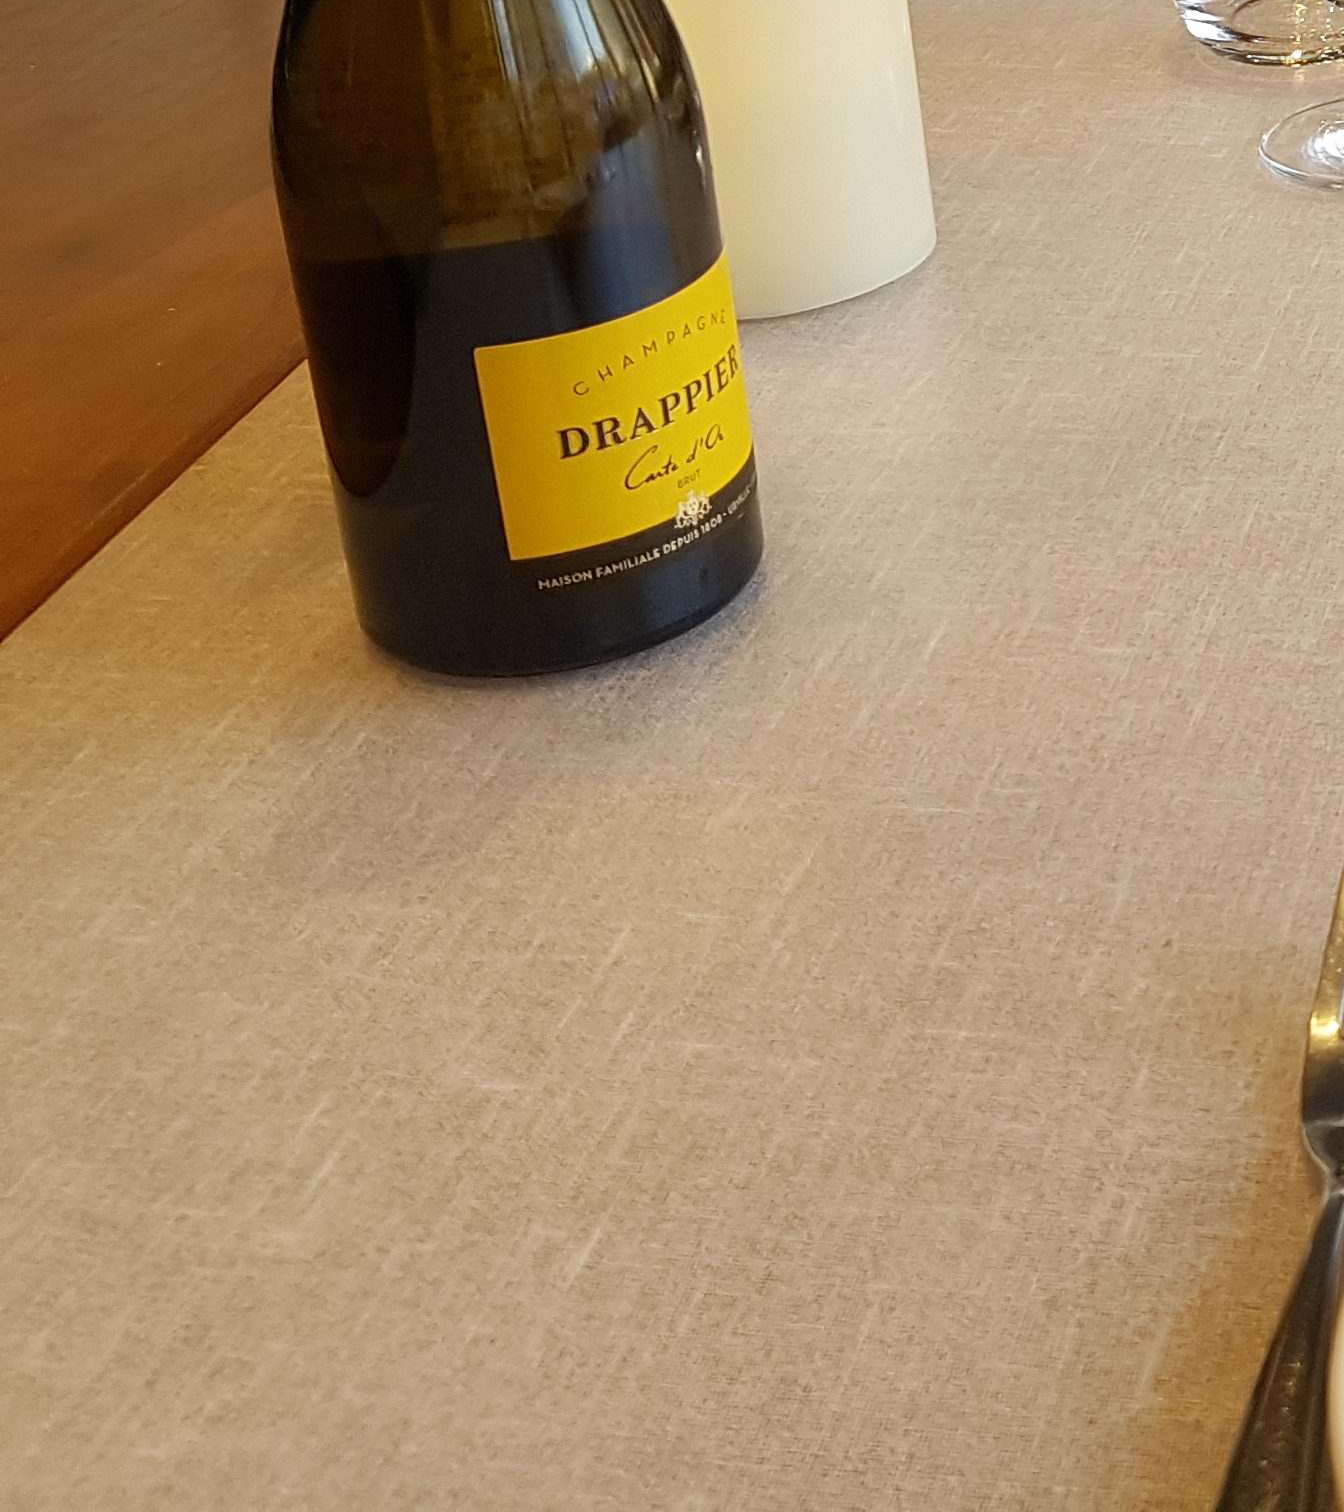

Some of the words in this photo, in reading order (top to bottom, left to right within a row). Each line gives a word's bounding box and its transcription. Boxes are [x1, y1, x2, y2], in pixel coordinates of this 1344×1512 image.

[572, 309, 727, 397] CHAMPAGNE
[556, 344, 740, 460] DRAPPIER
[624, 444, 680, 490] Carte
[676, 469, 701, 489] BRUT
[537, 569, 594, 590] MAISON
[595, 547, 661, 579] FAMILIALE
[662, 525, 700, 555] DEPUIS
